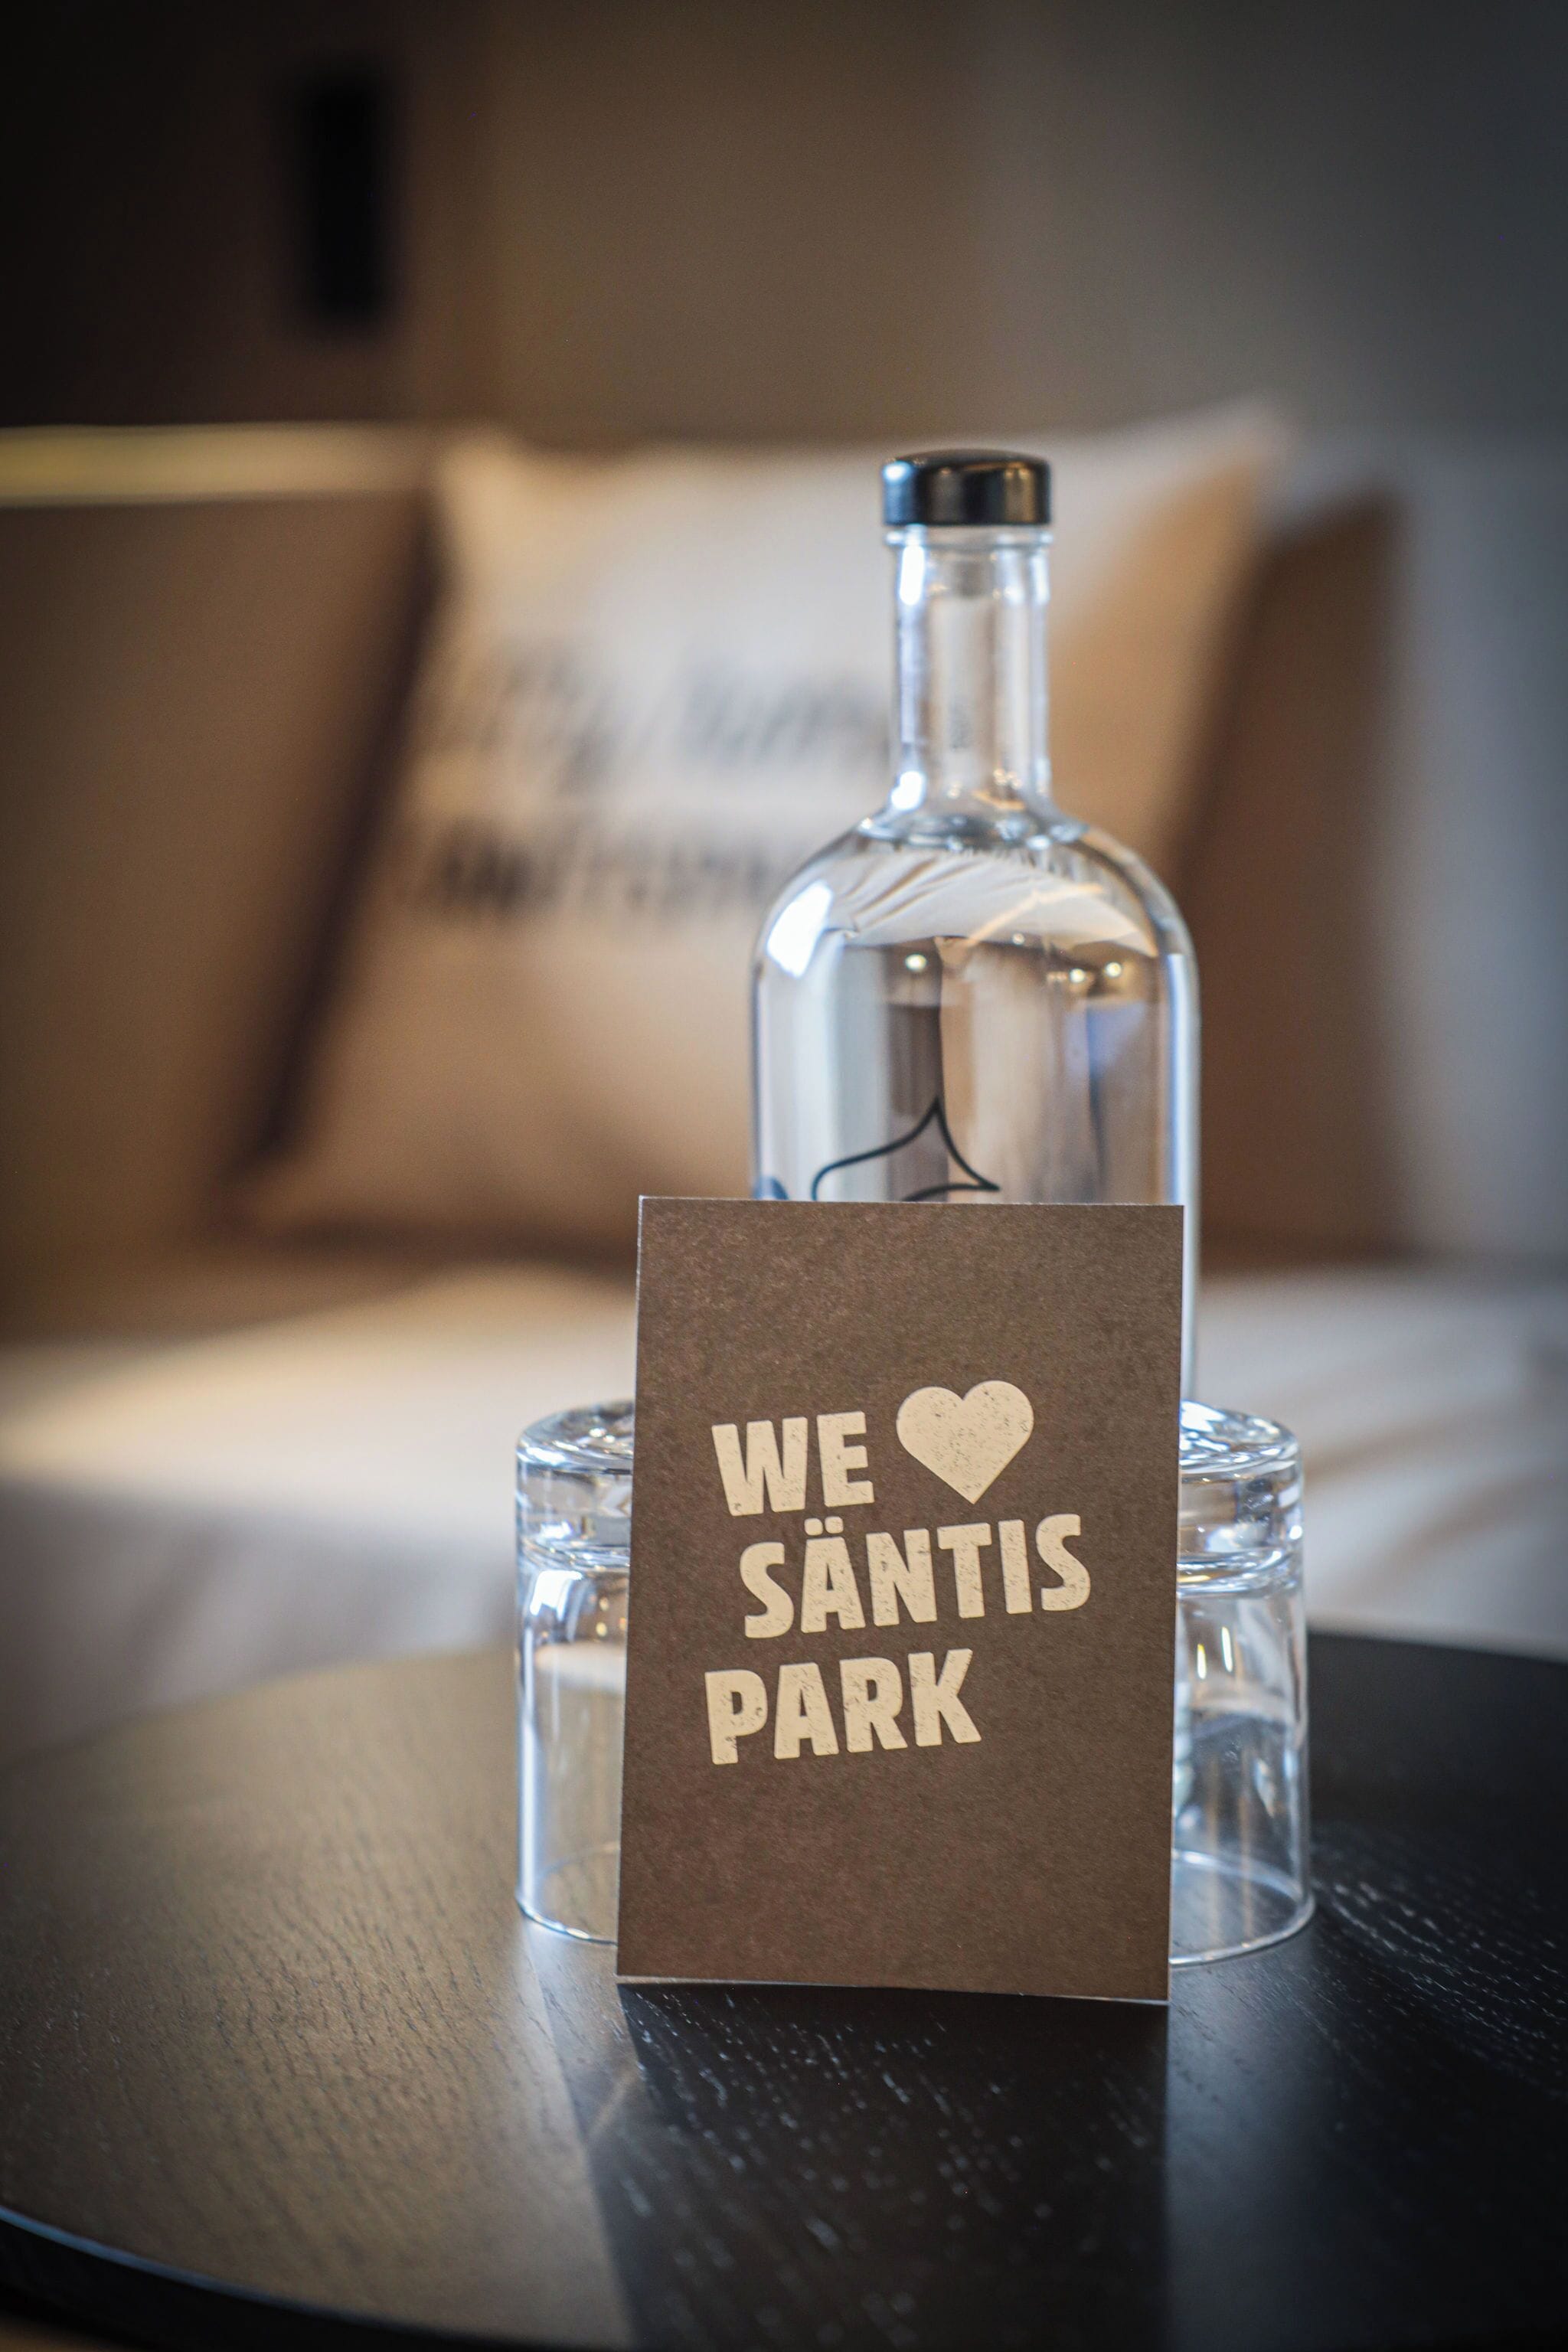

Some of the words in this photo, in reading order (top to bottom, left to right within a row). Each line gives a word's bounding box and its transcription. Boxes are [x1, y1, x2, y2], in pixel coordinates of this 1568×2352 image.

[711, 1411, 874, 1517] WE
[740, 1514, 1090, 1638] SÄNTIS
[704, 1648, 982, 1765] PARK
